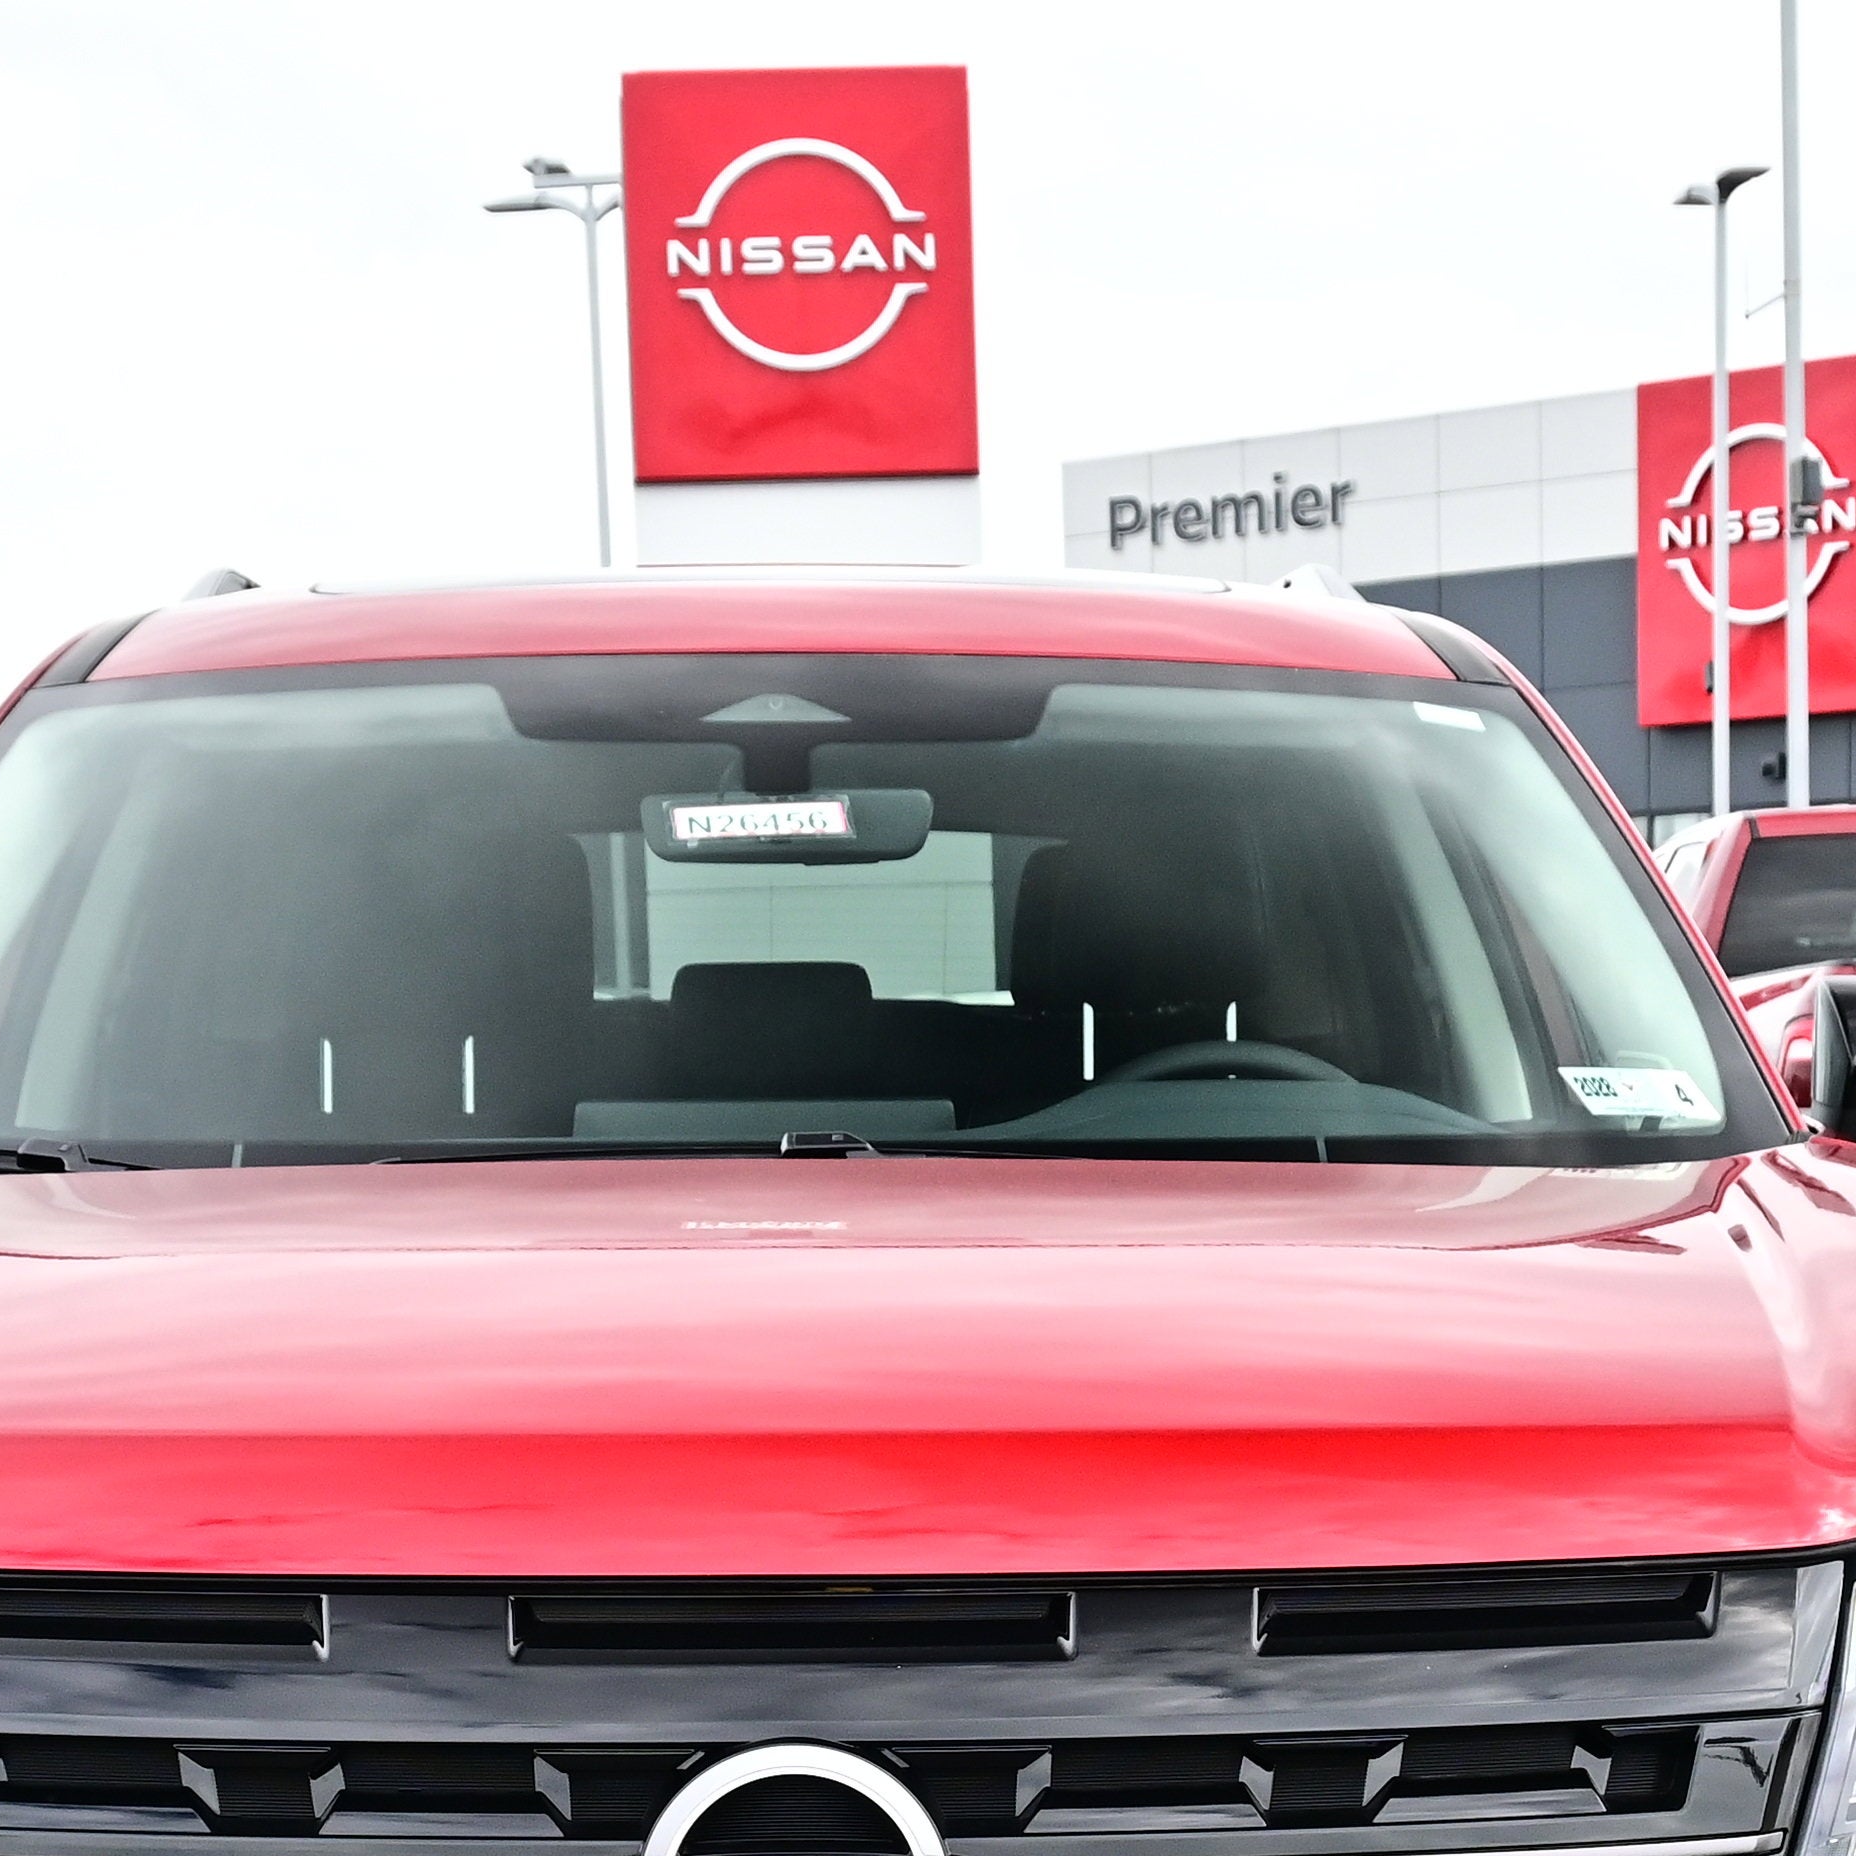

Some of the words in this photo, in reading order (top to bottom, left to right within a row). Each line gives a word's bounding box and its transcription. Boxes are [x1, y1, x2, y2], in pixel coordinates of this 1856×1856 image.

[666, 232, 937, 278] NISSAN
[1108, 471, 1356, 551] Premier
[687, 810, 829, 836] N26456
